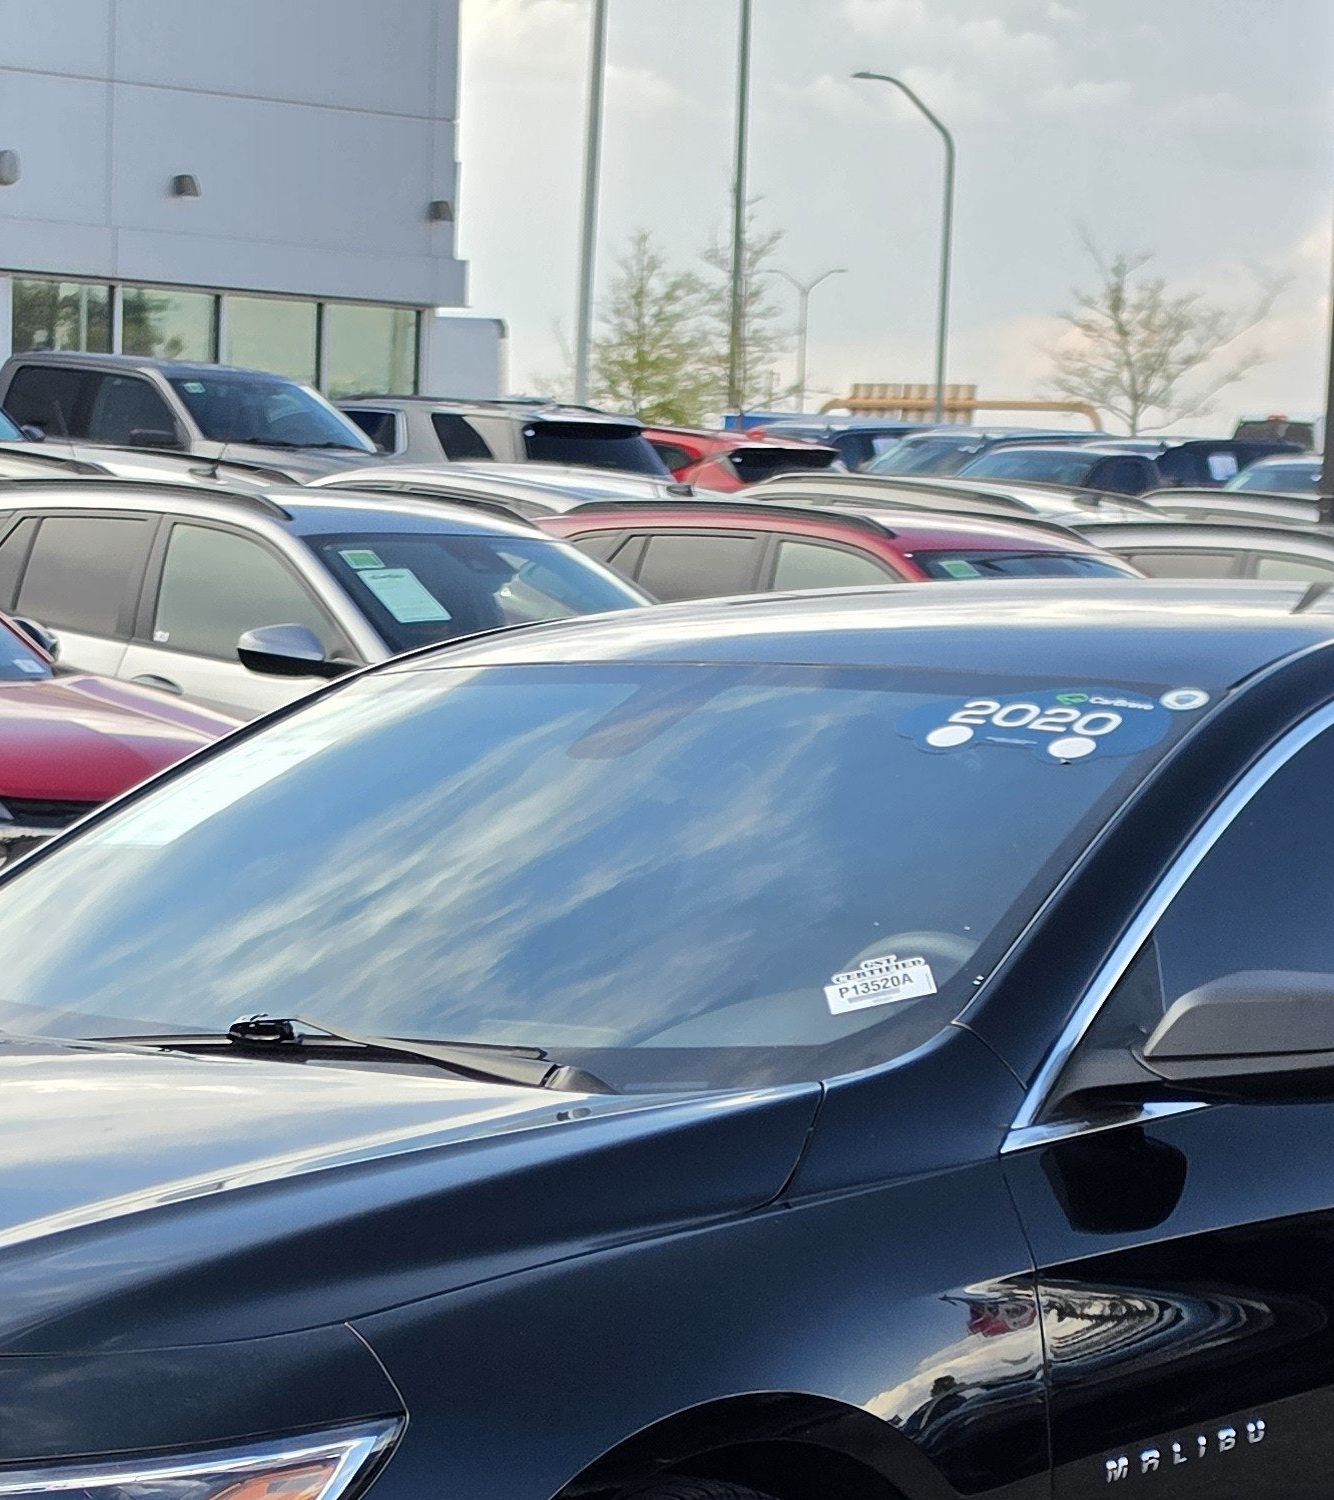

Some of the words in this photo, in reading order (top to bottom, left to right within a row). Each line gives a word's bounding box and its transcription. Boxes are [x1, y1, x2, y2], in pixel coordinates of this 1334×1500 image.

[947, 700, 1123, 737] 2020
[835, 959, 923, 983] CERTIFIED
[838, 973, 914, 999] P13520A
[1104, 1419, 1266, 1484] MALIBU
